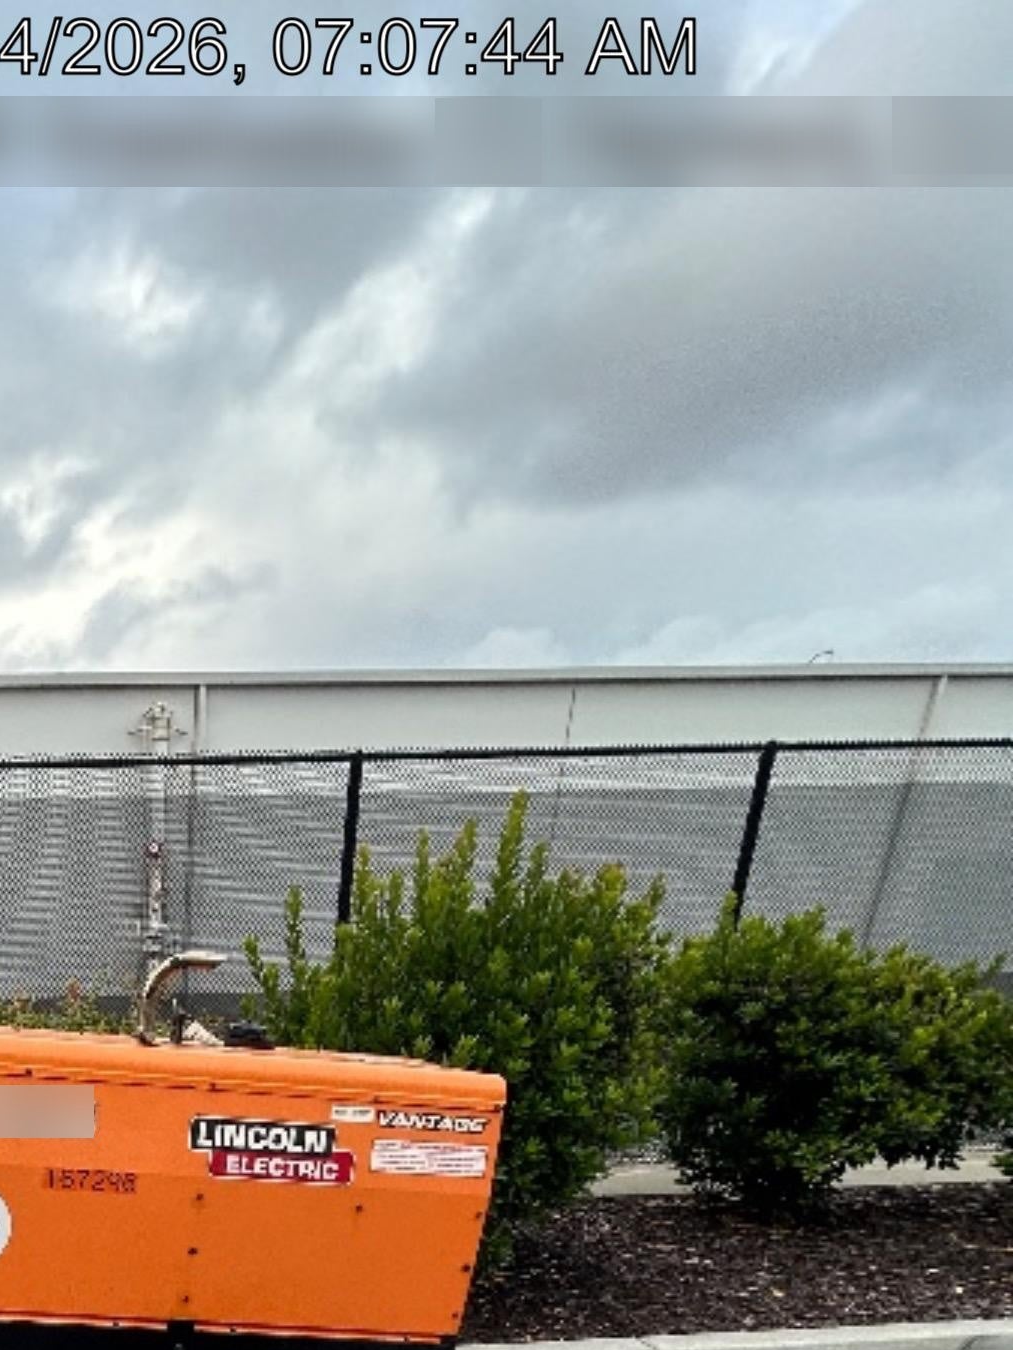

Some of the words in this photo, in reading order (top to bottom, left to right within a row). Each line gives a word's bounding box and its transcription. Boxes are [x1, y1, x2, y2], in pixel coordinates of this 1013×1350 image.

[378, 1108, 490, 1133] VANTAGE
[196, 1121, 328, 1154] LINCOLN
[225, 1154, 340, 1181] ELECTRIC
